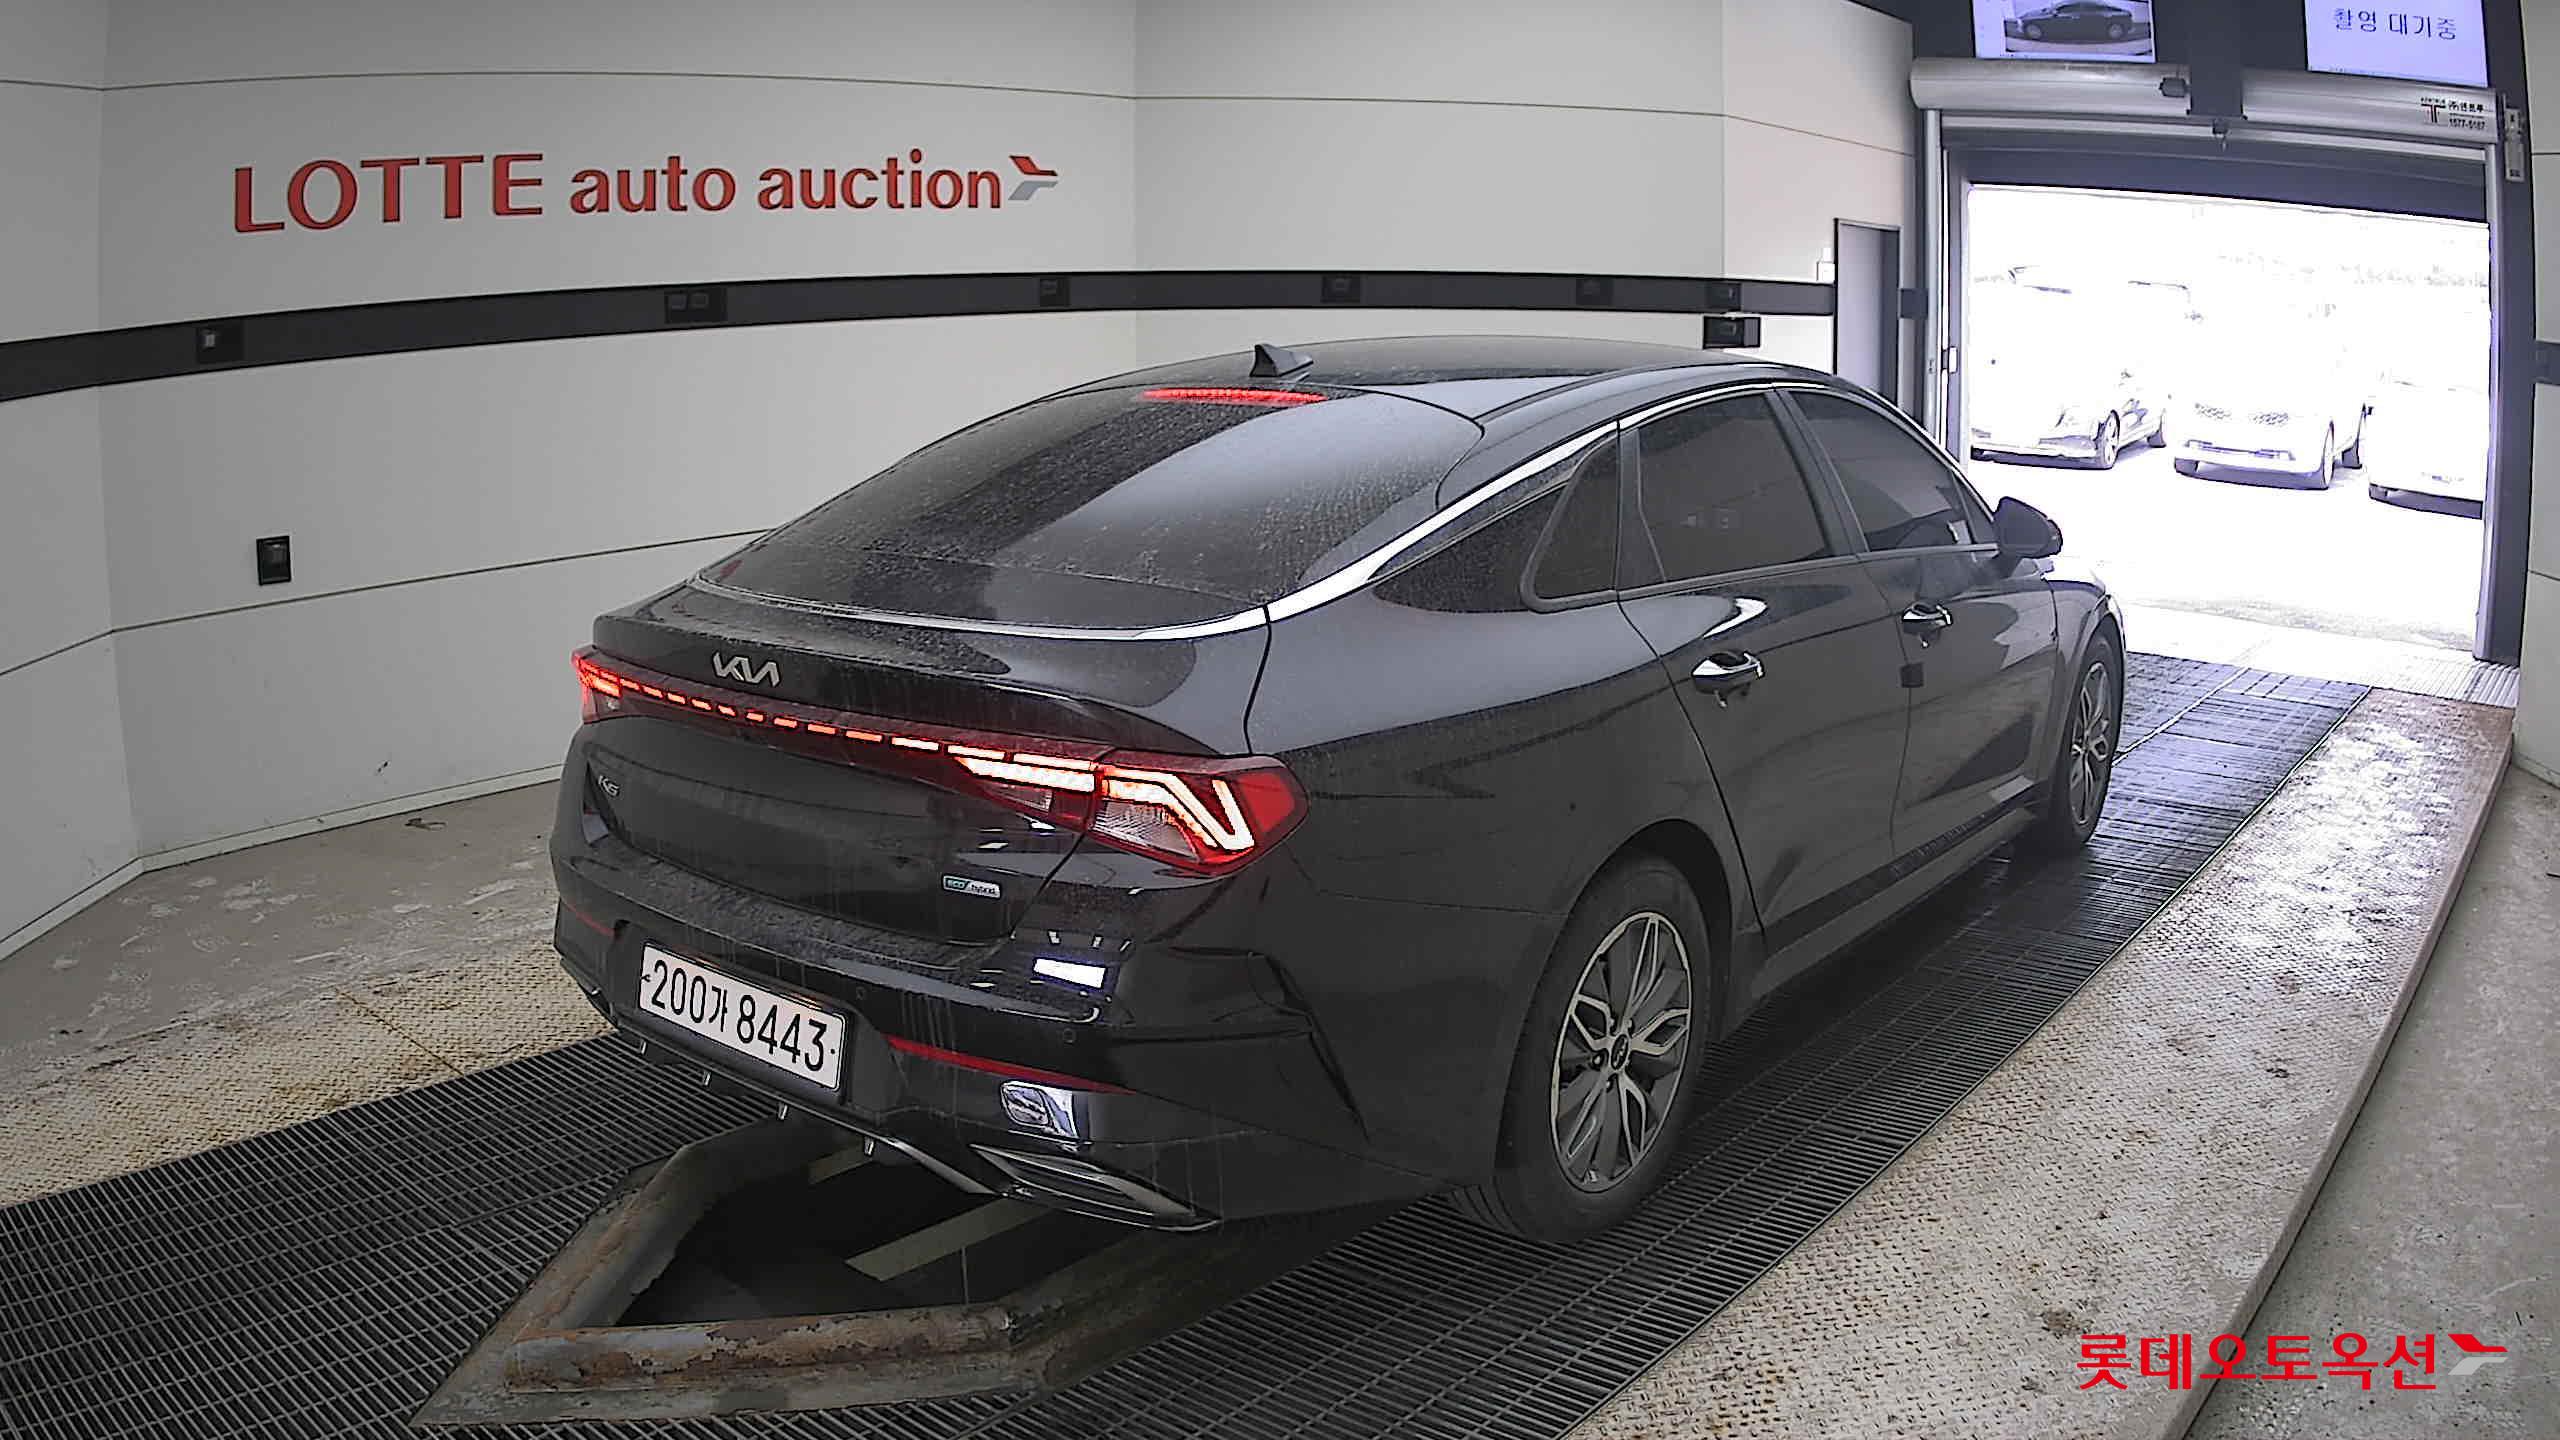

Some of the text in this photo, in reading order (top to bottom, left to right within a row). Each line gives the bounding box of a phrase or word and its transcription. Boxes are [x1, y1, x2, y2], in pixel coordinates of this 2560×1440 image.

[2389, 13, 2457, 41] 대기중
[234, 147, 1001, 233] LOTTE auto auction
[712, 651, 780, 688] KIA
[650, 959, 828, 1072] 200가 8443
